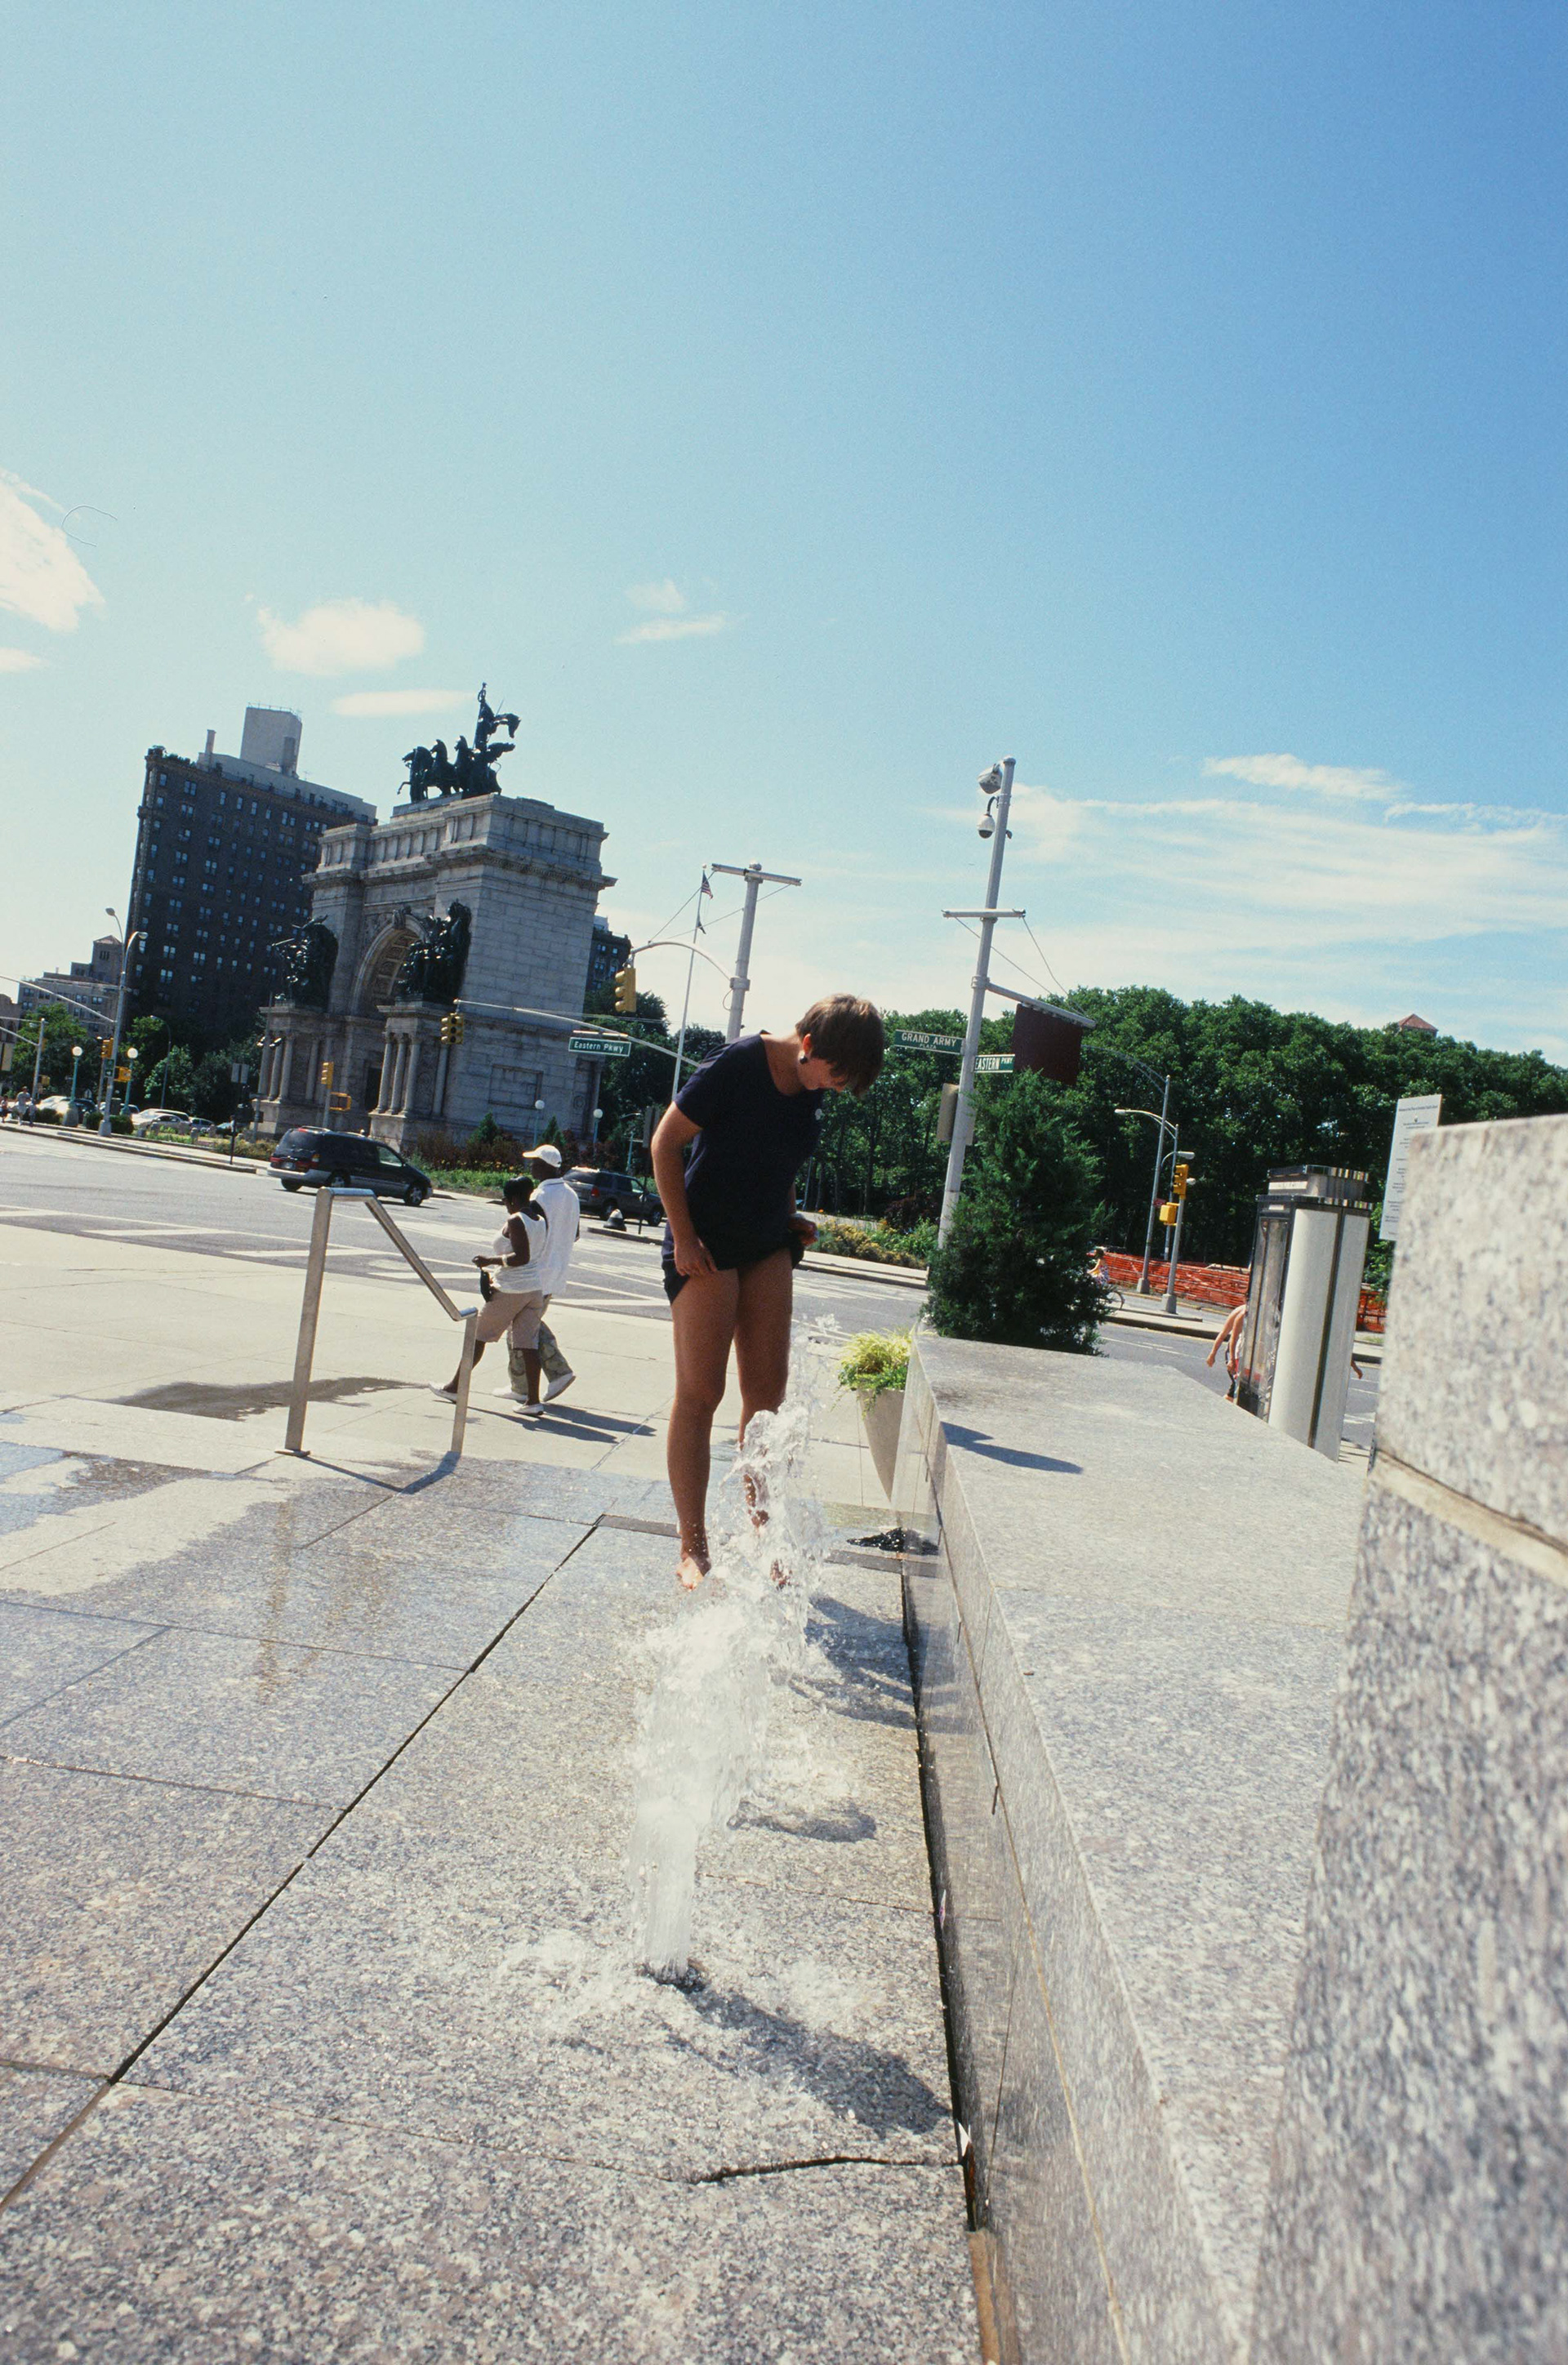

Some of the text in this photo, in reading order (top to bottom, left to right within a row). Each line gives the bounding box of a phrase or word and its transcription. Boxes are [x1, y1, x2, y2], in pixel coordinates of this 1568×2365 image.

[902, 1032, 957, 1047] GRAND ARMY
[574, 1041, 624, 1053] Eastern Pkwy
[974, 1057, 1000, 1071] EASTERN
